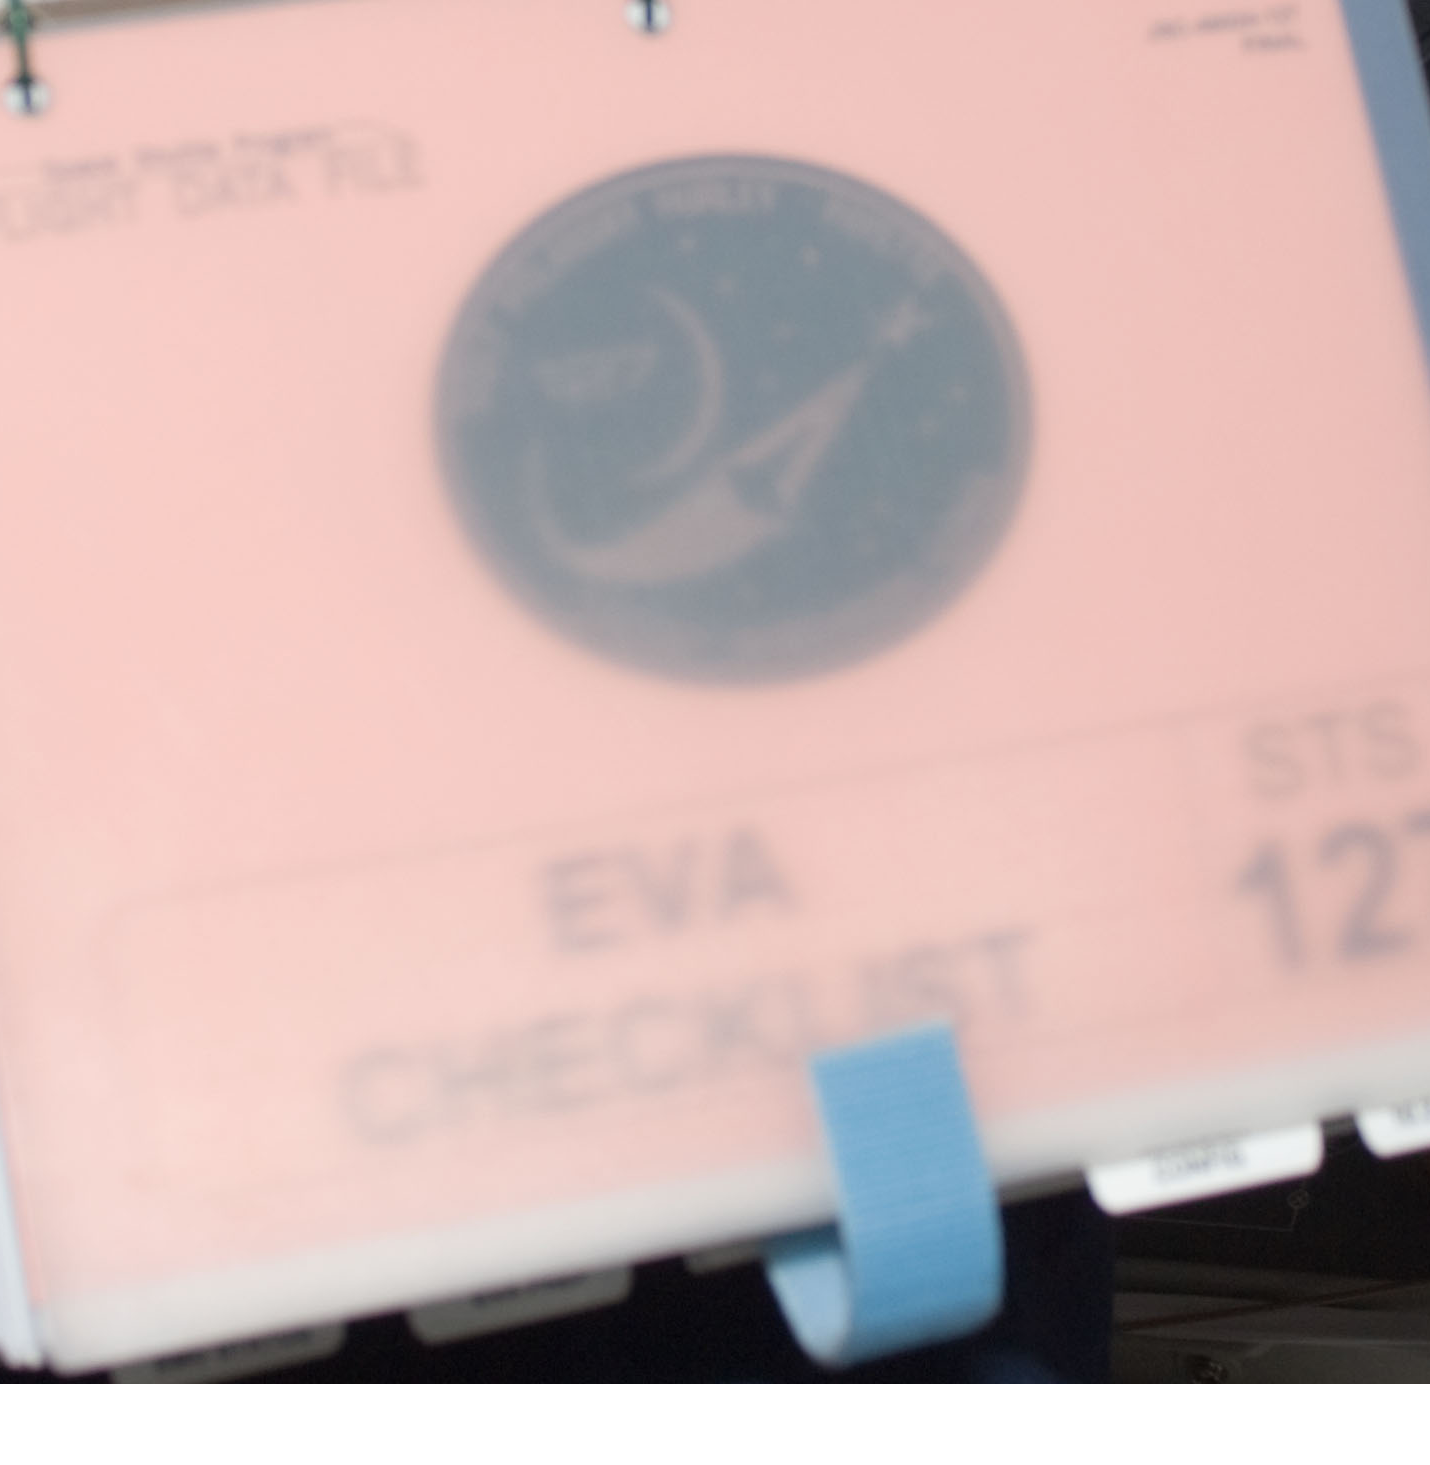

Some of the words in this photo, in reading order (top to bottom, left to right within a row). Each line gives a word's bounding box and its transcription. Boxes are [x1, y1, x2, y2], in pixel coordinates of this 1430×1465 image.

[174, 159, 297, 220] DATA
[326, 136, 426, 201] FILE
[1238, 703, 1420, 803] STS
[537, 828, 799, 954] EVA
[337, 926, 1038, 1144] CHECKLIST
